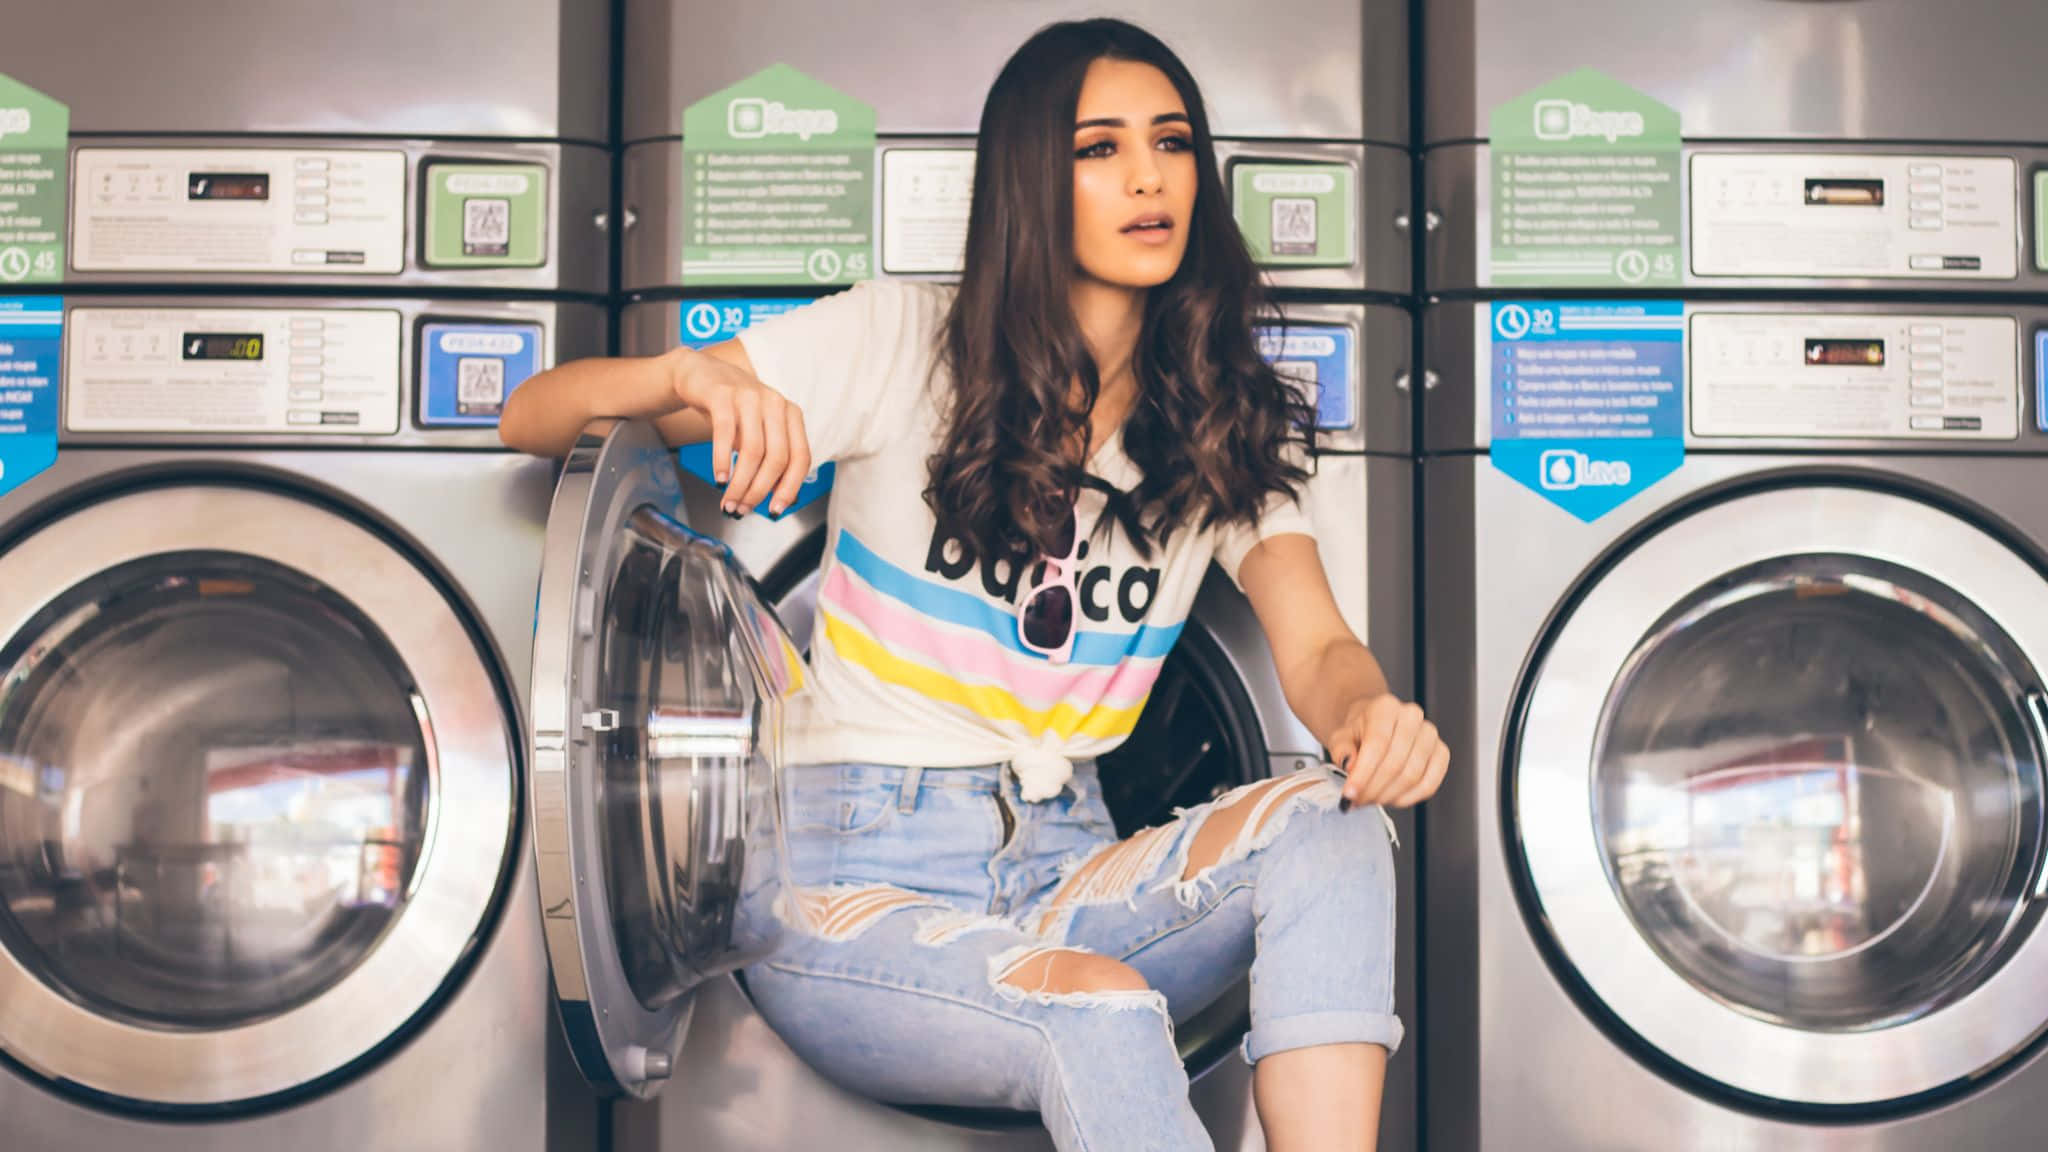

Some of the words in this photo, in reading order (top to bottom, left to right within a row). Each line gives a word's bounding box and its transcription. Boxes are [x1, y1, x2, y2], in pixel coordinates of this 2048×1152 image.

[34, 251, 56, 271] 45
[845, 253, 867, 271] 45
[1653, 254, 1675, 272] 45
[722, 307, 744, 326] 30
[1533, 309, 1554, 327] 30
[925, 513, 1161, 624] baca
